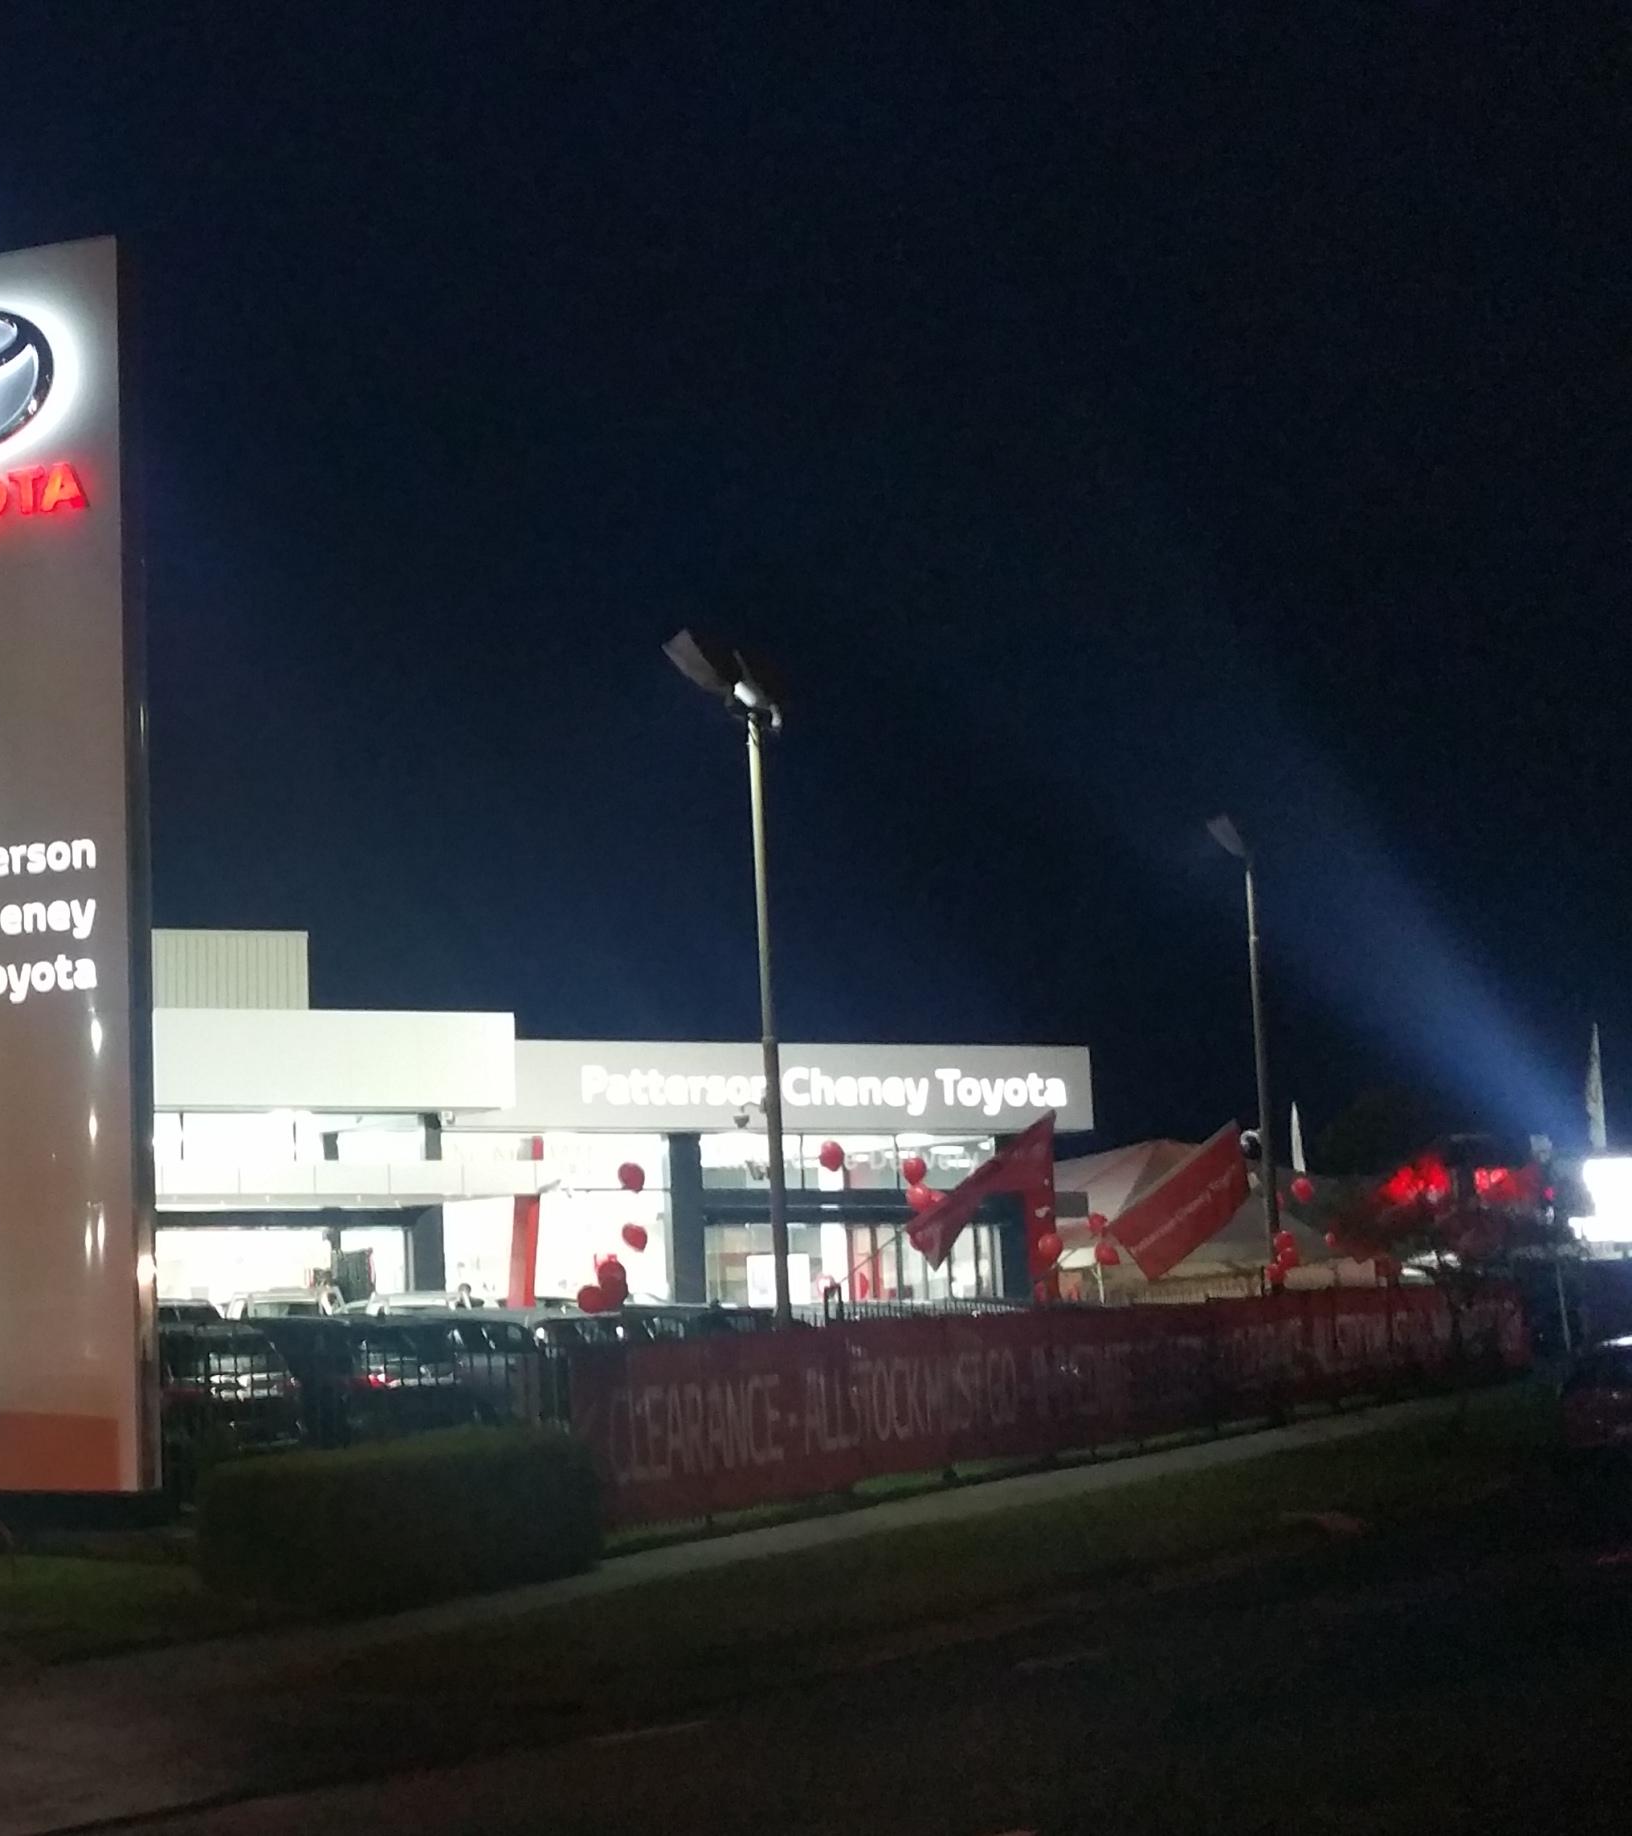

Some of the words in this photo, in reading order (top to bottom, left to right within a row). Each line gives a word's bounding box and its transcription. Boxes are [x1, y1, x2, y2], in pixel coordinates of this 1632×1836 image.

[580, 1065, 766, 1106] Patterson
[781, 1067, 928, 1116] Cheney
[935, 1068, 1067, 1116] Toyota
[609, 1373, 784, 1485] CLEARANCE
[805, 1366, 858, 1455] ALL
